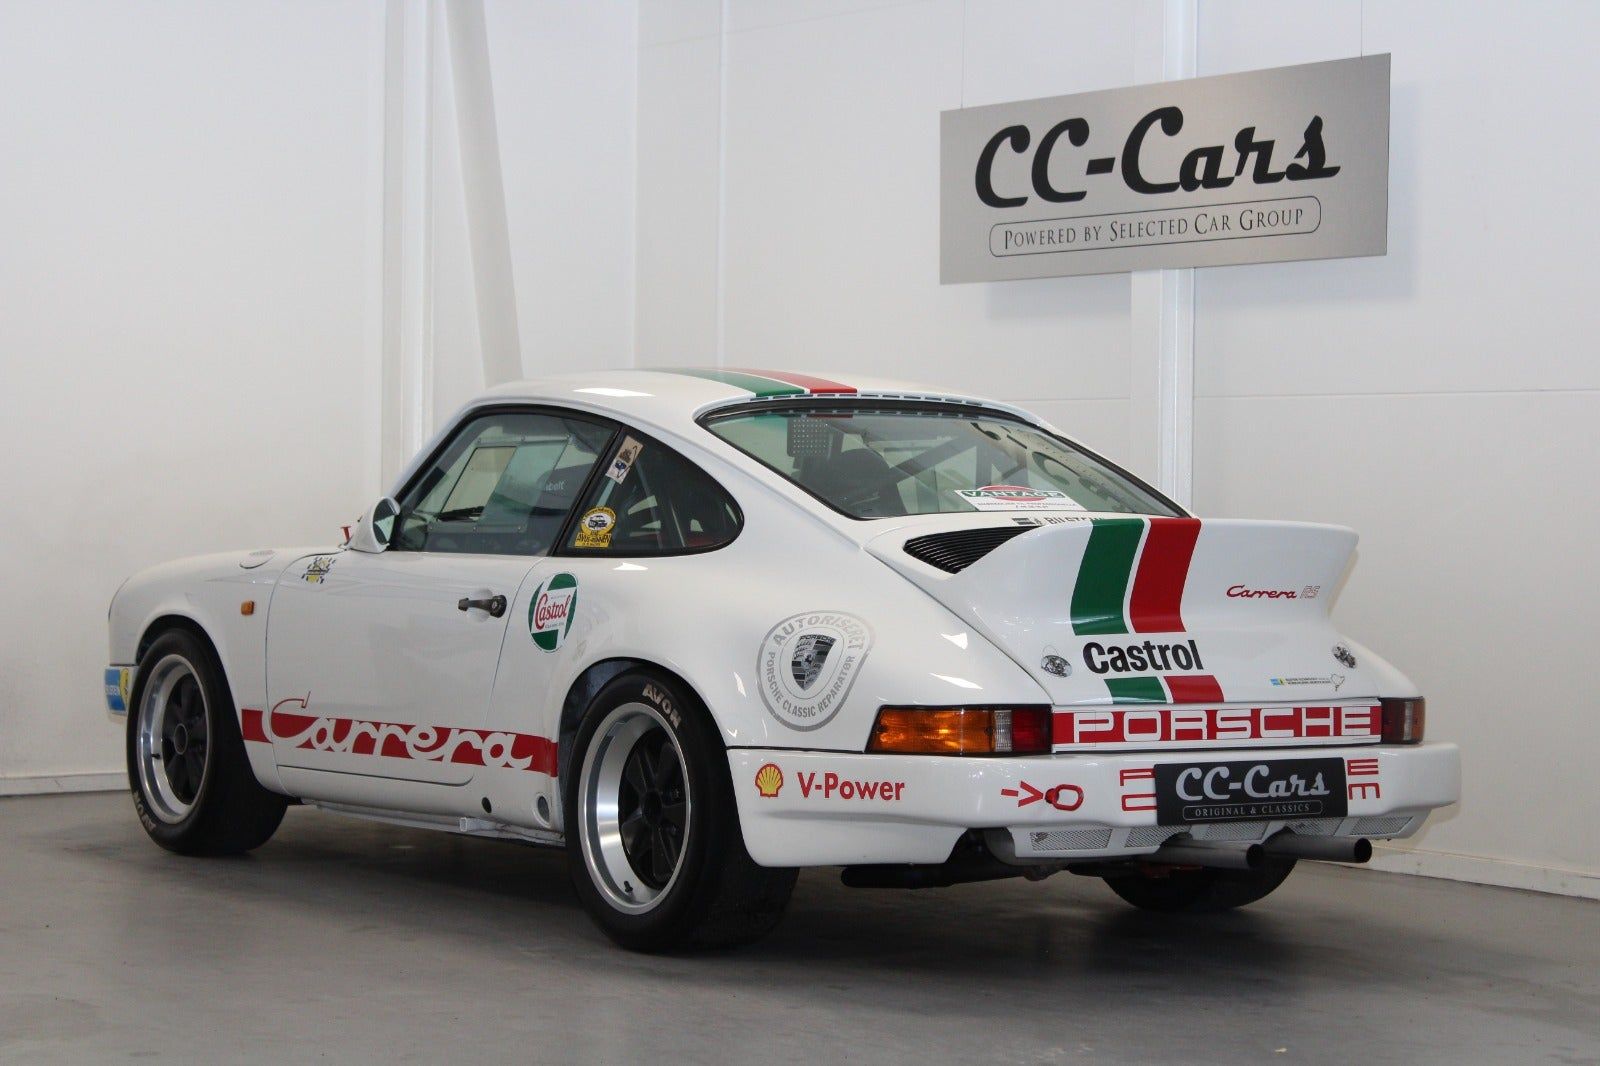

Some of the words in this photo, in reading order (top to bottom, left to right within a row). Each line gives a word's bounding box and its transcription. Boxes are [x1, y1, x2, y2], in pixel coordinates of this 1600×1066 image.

[975, 106, 1341, 208] CC-Cars
[1226, 585, 1297, 599] Carrera
[535, 593, 571, 630] Castrol
[1083, 640, 1204, 674] Castrol
[766, 651, 784, 703] PORSCHE
[782, 700, 816, 718] CLASSIC
[642, 683, 681, 729] AVON
[262, 691, 533, 770] Carrera
[1074, 707, 1371, 743] PORSCHE
[797, 772, 905, 801] V-Power
[1175, 764, 1331, 801] CC-Cars
[1195, 807, 1246, 817] ORIGINAL
[1250, 806, 1257, 814] &
[1261, 803, 1310, 814] CLASSICS
